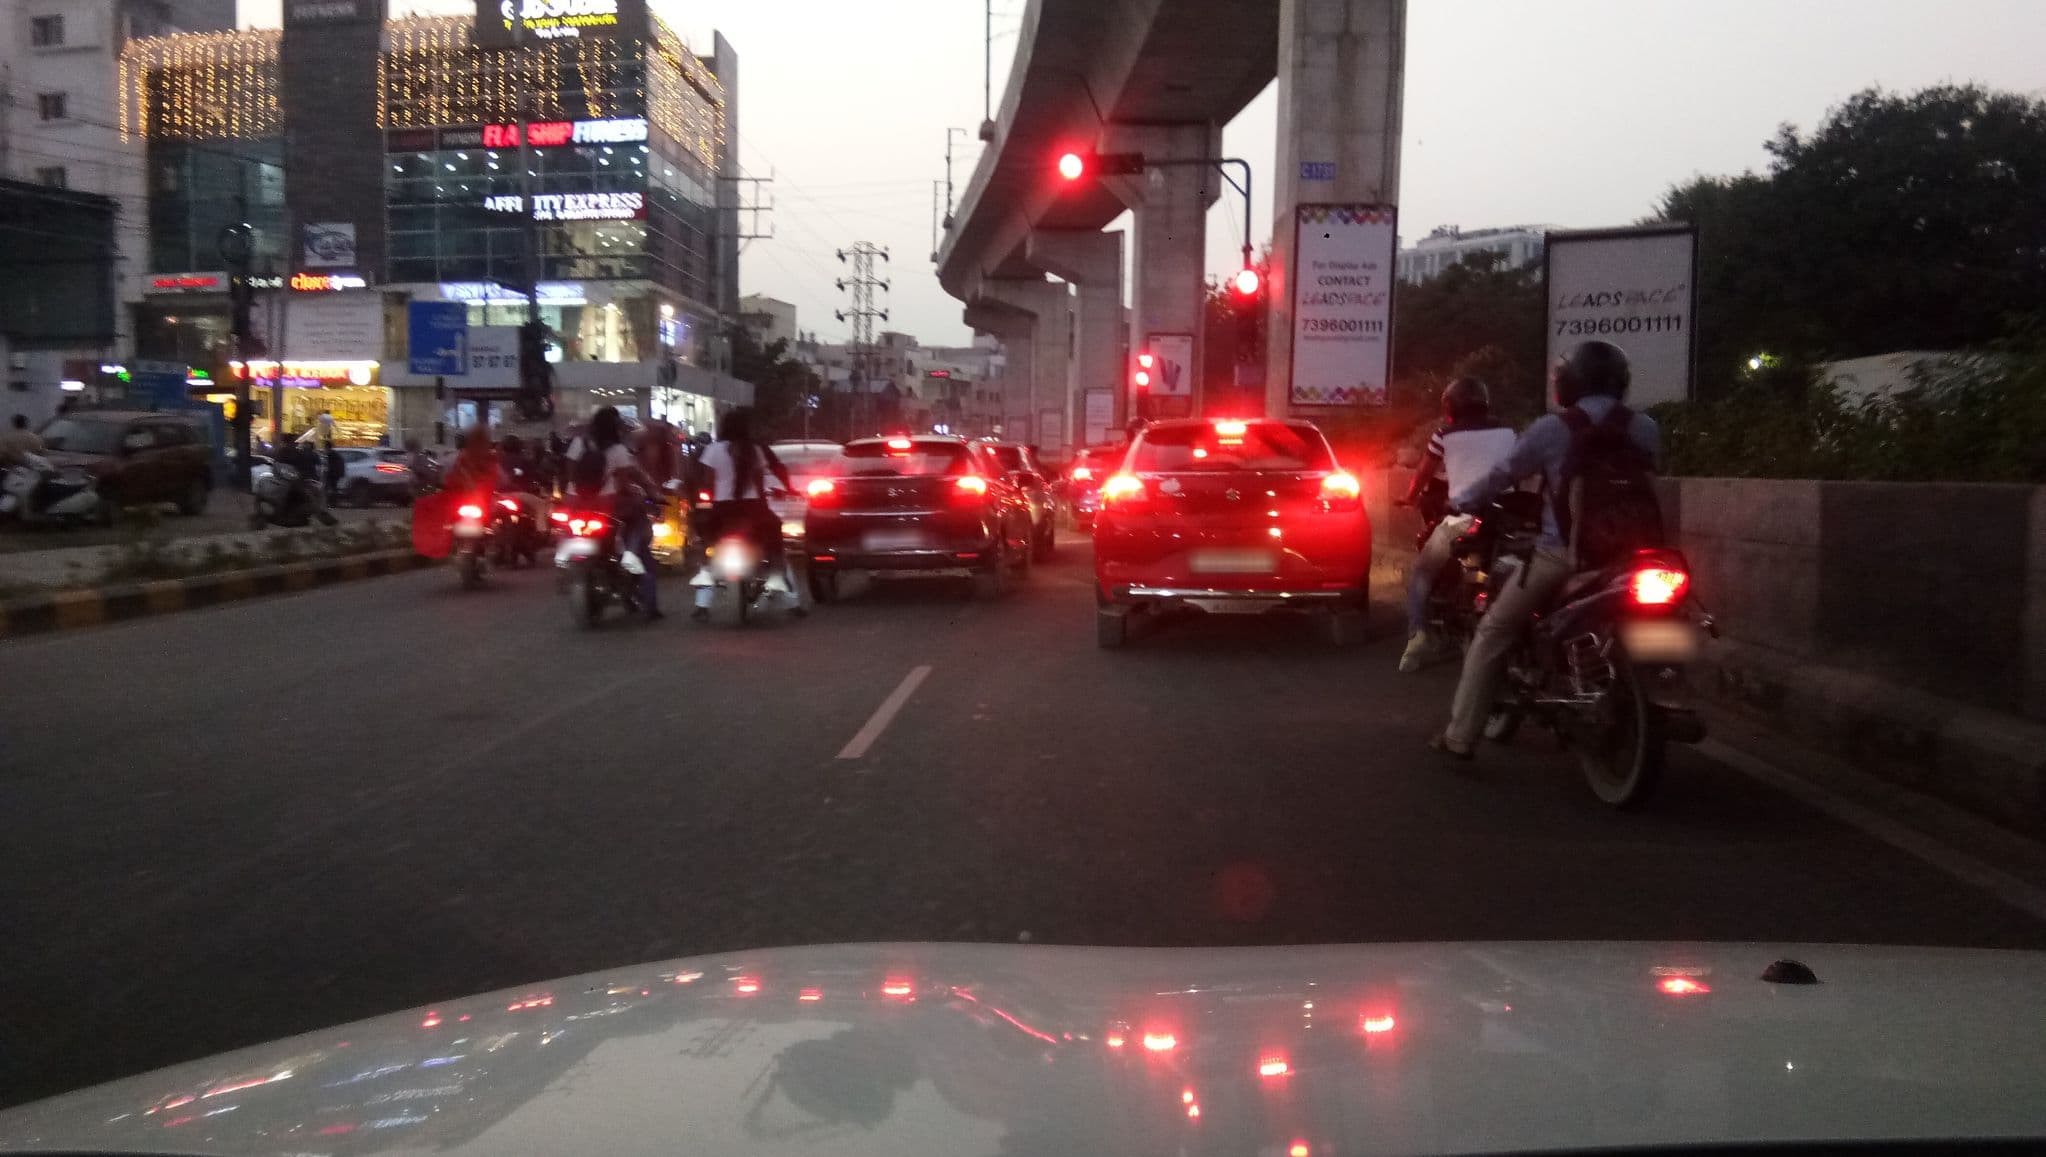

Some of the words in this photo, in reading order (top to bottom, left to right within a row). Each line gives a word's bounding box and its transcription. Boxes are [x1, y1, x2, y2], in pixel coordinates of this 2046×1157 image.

[483, 121, 573, 147] FLASHIP
[484, 194, 563, 213] AFFIITY
[563, 192, 644, 210] EXPRESS
[1317, 275, 1371, 286] CONTACT
[1302, 319, 1384, 333] 7396001111
[1555, 314, 1682, 336] 7396001111
